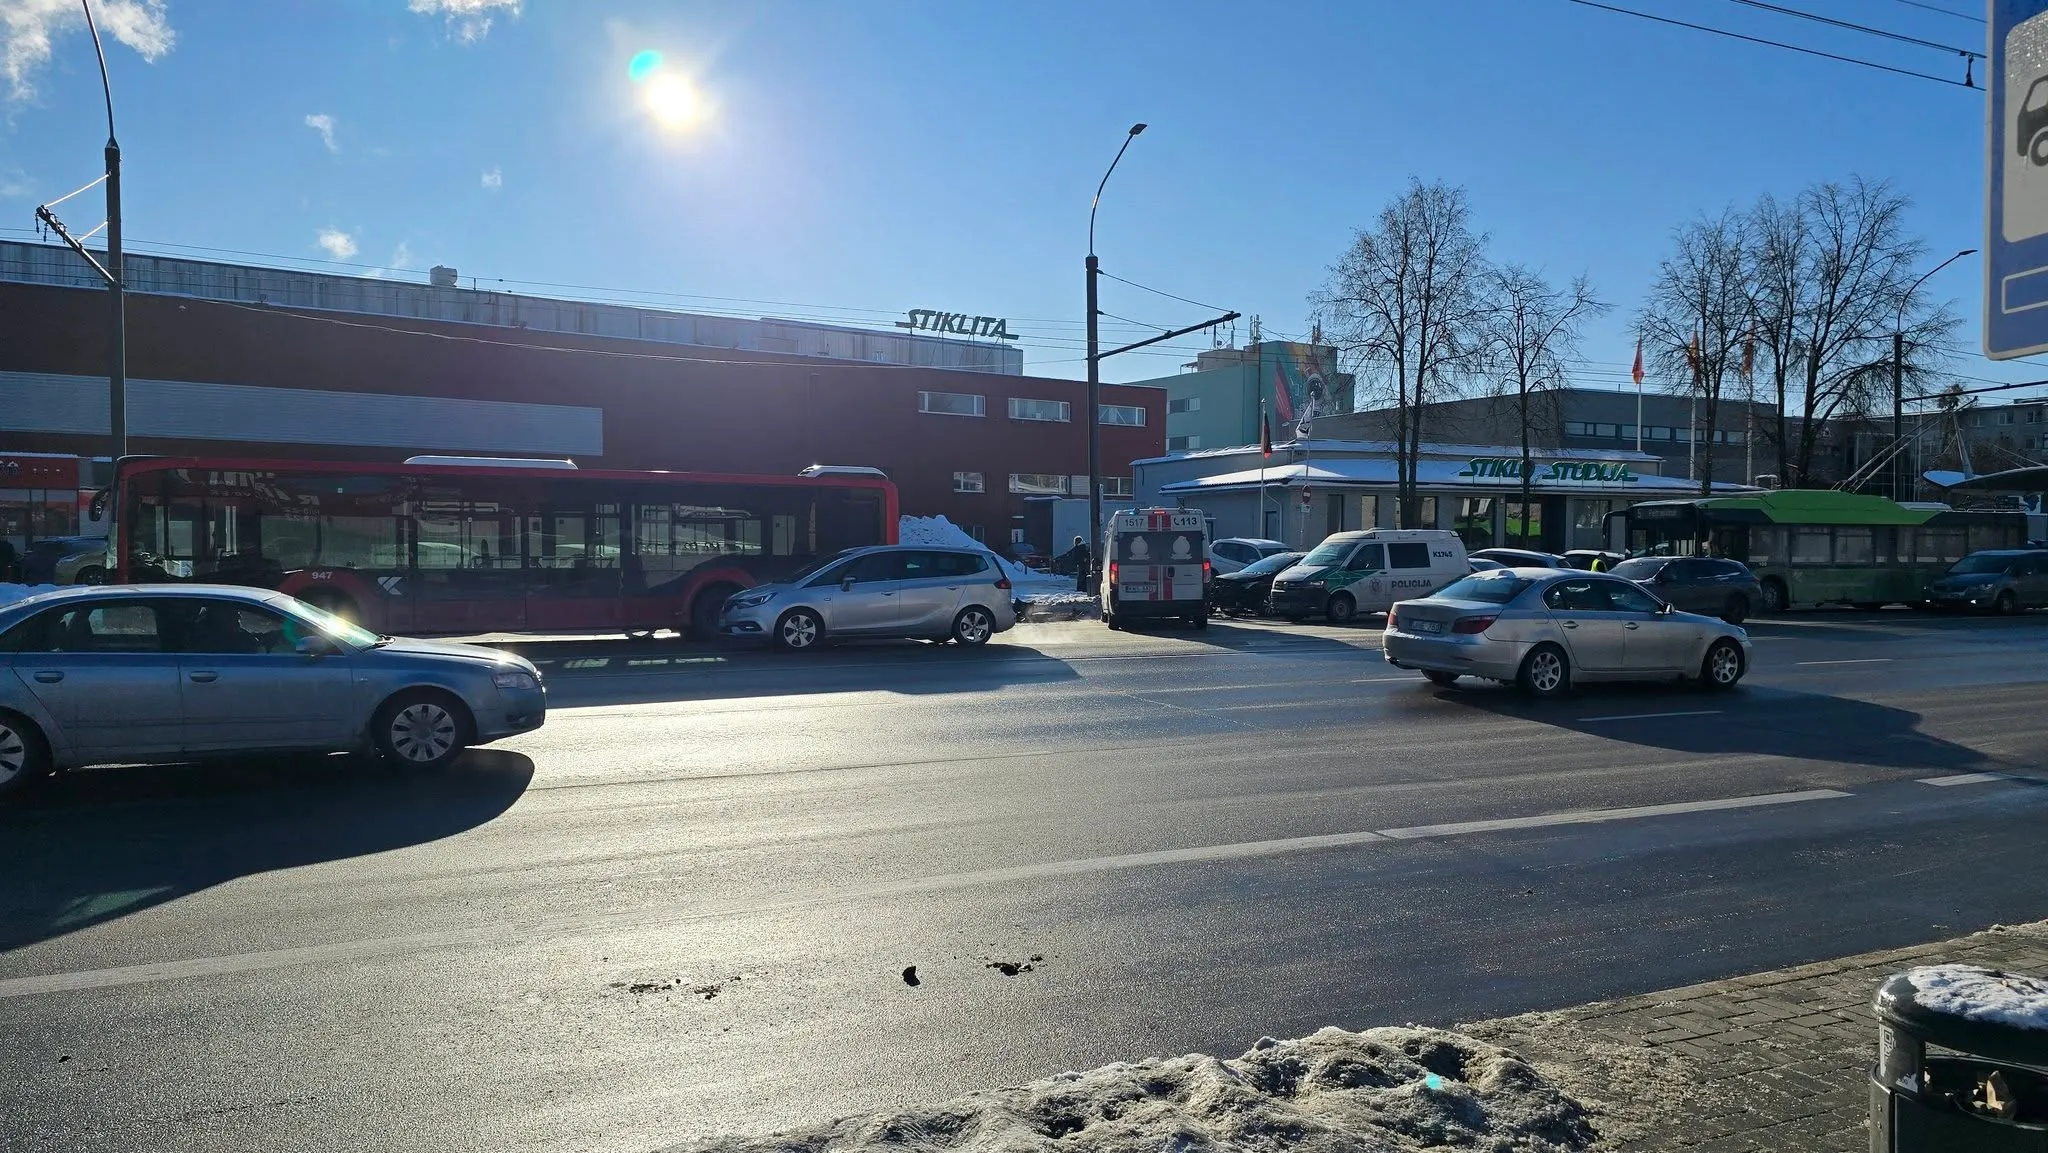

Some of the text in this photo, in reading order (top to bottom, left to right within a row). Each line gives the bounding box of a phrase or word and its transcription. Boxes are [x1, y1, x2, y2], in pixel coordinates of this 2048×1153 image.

[895, 308, 1020, 340] STIKLITA
[1459, 457, 1638, 481] STIKLO STUDIJA
[1125, 518, 1144, 527] 1517
[1180, 517, 1197, 526] 113
[311, 571, 333, 580] 947
[1391, 579, 1432, 589] POLICIJA
